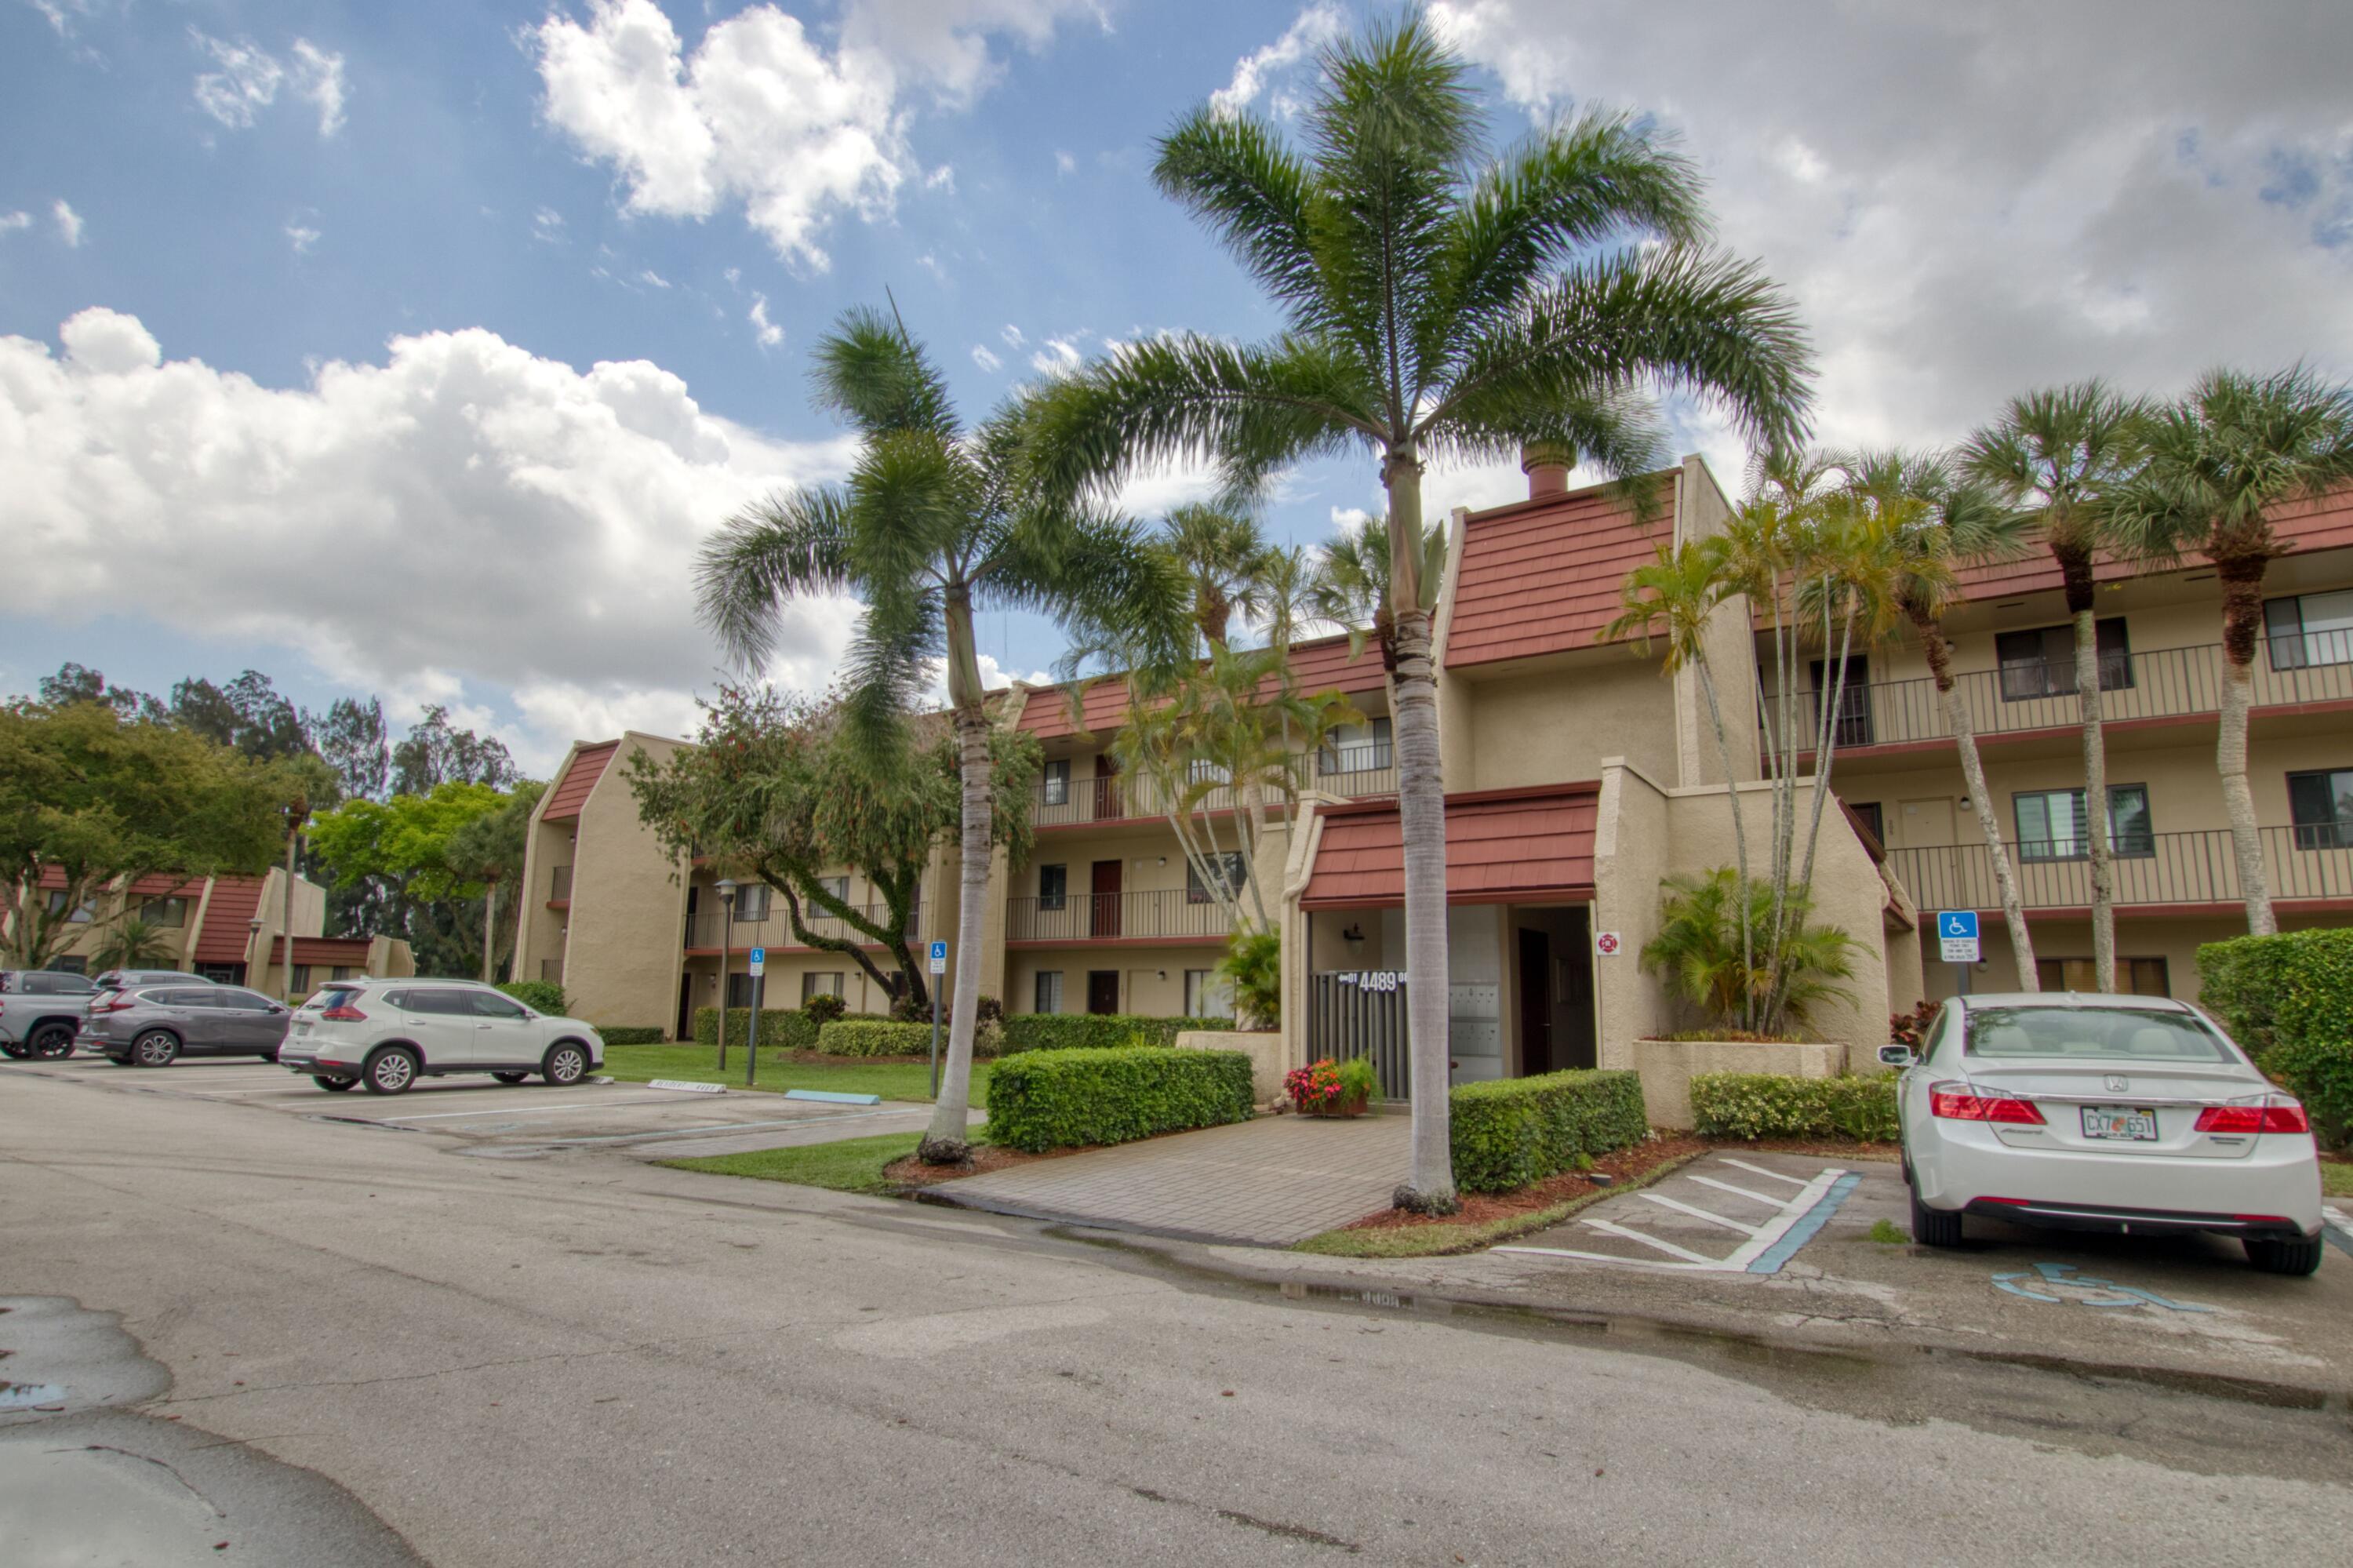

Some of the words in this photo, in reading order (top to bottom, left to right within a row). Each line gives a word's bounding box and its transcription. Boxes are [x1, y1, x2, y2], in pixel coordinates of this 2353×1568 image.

[1360, 972, 1396, 991] 4489
[2087, 1115, 2111, 1130] CX7
[2127, 1117, 2151, 1133] 651
